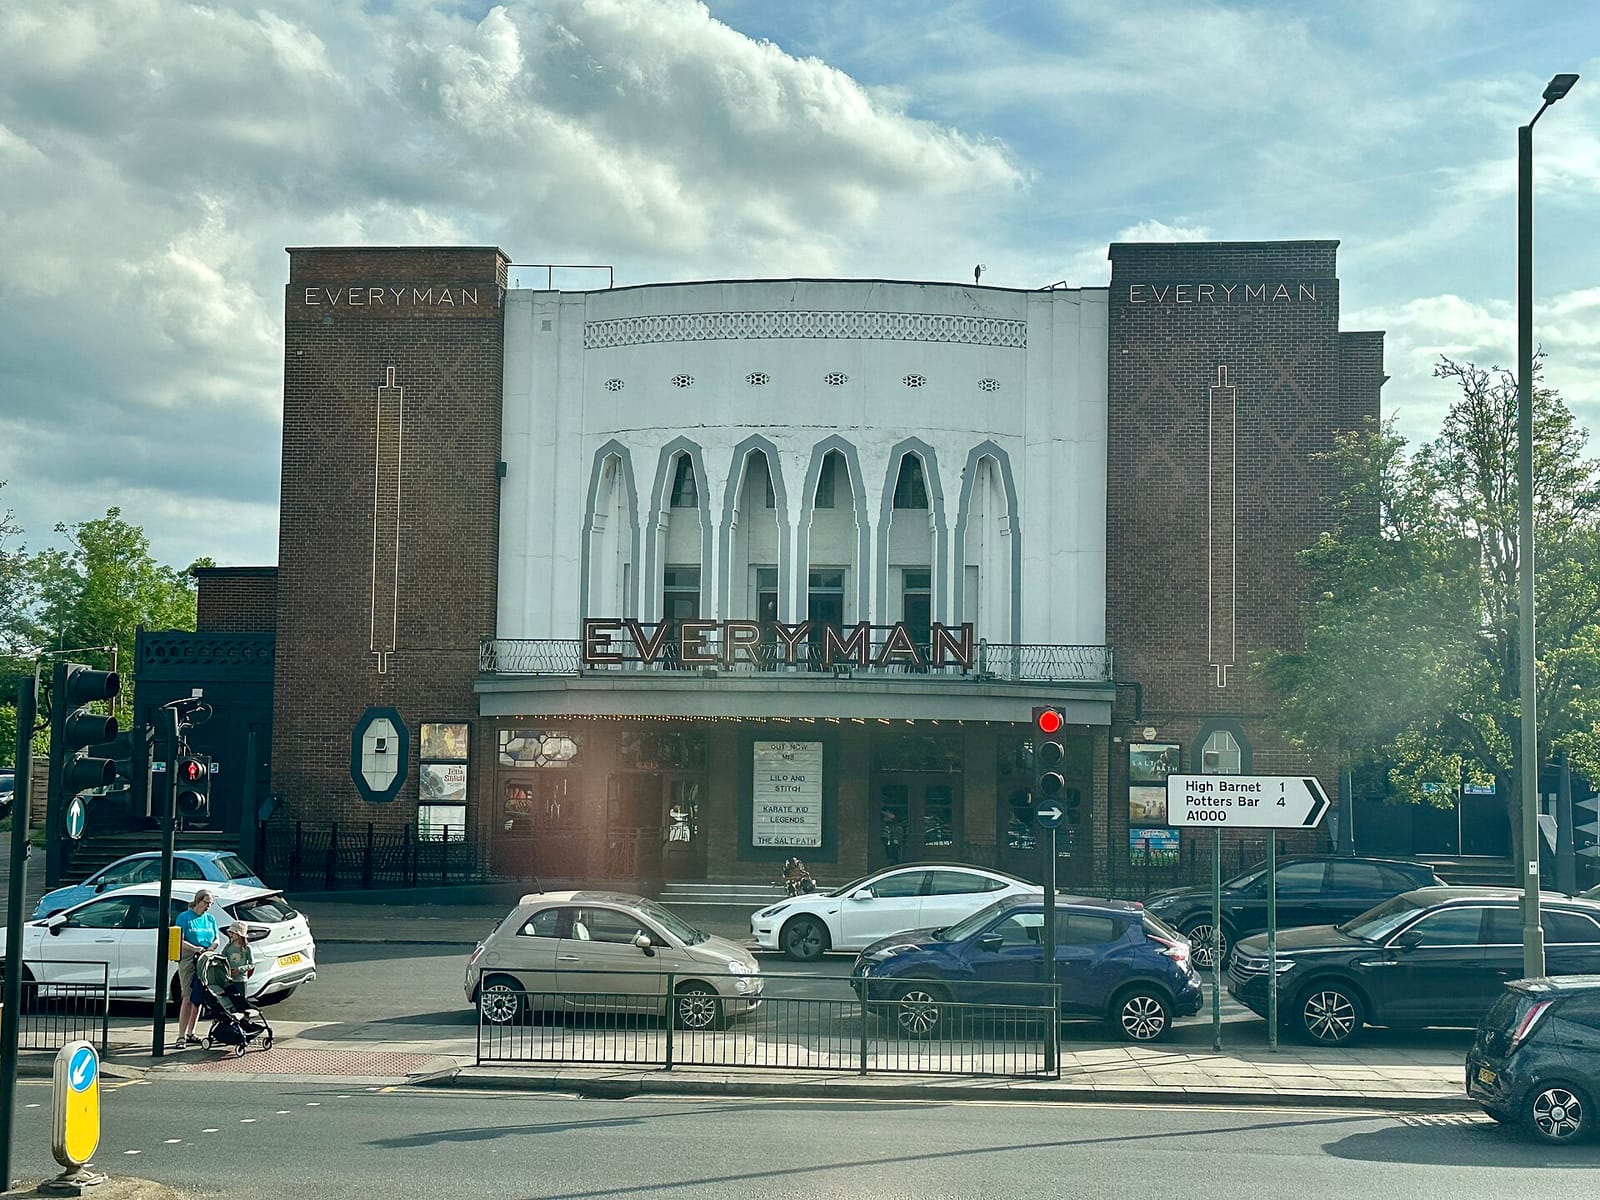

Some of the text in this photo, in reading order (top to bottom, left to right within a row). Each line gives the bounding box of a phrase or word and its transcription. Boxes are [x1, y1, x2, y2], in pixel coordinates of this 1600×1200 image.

[305, 287, 479, 306] EVERYMAN
[1129, 283, 1316, 303] EVERYMAN
[583, 617, 973, 669] EVERYMAN
[770, 743, 808, 751] OUT NOW
[1185, 780, 1285, 793] High Barnet 1
[1185, 796, 1286, 808] Potters Bar 4
[763, 806, 809, 814] KARATE KID
[1186, 810, 1227, 822] A1000
[770, 816, 805, 824] LEGENDS
[758, 837, 816, 846] THE SALT PATH
